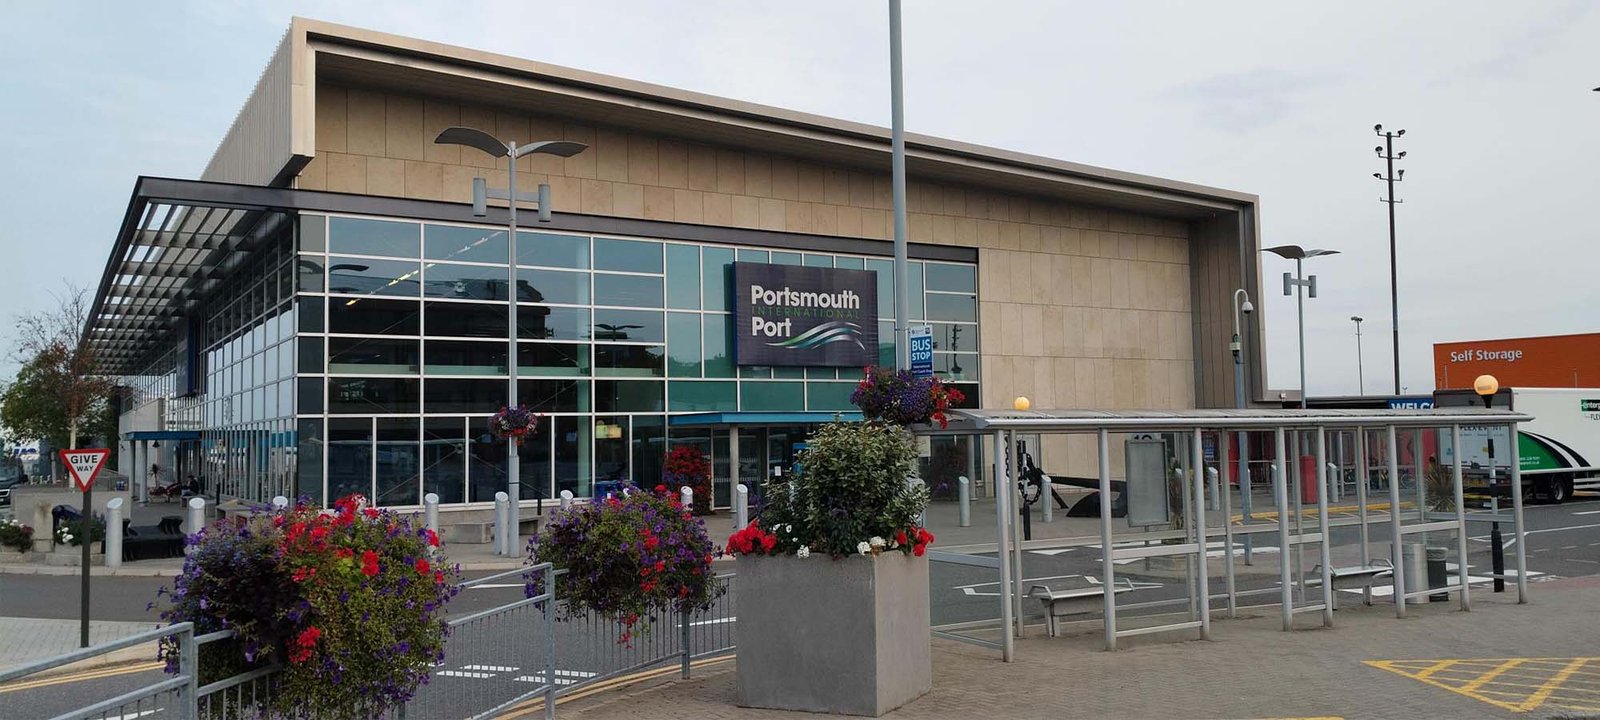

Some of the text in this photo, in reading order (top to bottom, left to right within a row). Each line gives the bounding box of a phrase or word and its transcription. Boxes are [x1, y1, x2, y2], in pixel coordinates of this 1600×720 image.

[751, 285, 860, 309] Portsmouth
[751, 305, 861, 319] INTERNATIONAL
[752, 316, 791, 337] Port
[911, 338, 931, 352] BUS
[911, 351, 931, 361] STOP
[1450, 349, 1522, 362] Self Storage
[1390, 402, 1434, 410] WELC
[70, 454, 98, 464] GIVE
[76, 464, 94, 472] WAY
